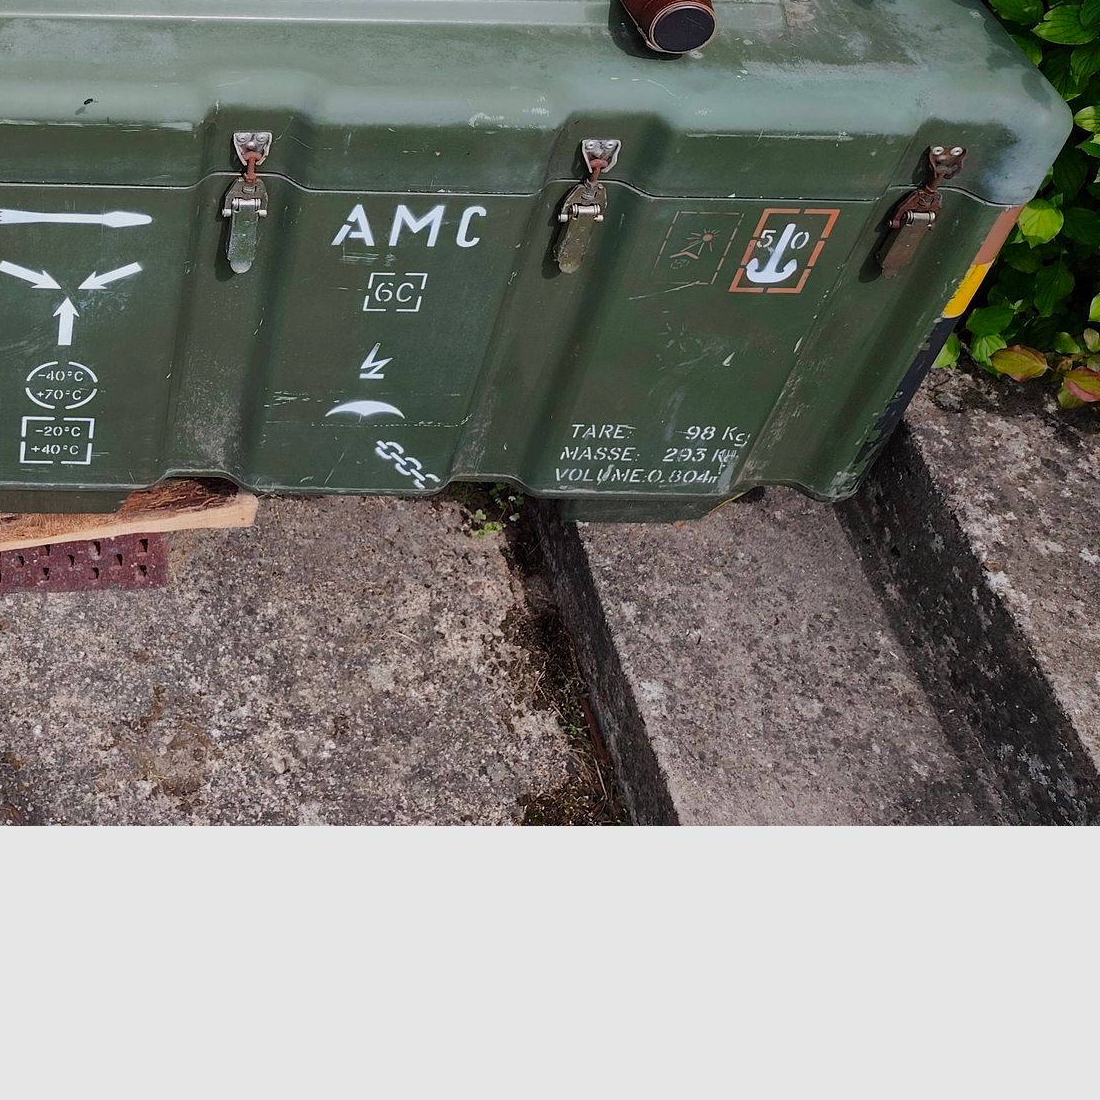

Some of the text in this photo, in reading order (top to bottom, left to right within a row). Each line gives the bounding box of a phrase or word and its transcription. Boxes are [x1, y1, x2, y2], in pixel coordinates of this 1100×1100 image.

[331, 203, 487, 248] AMC
[374, 282, 415, 303] 6C
[684, 425, 716, 440] 98
[560, 446, 640, 462] MASSE:
